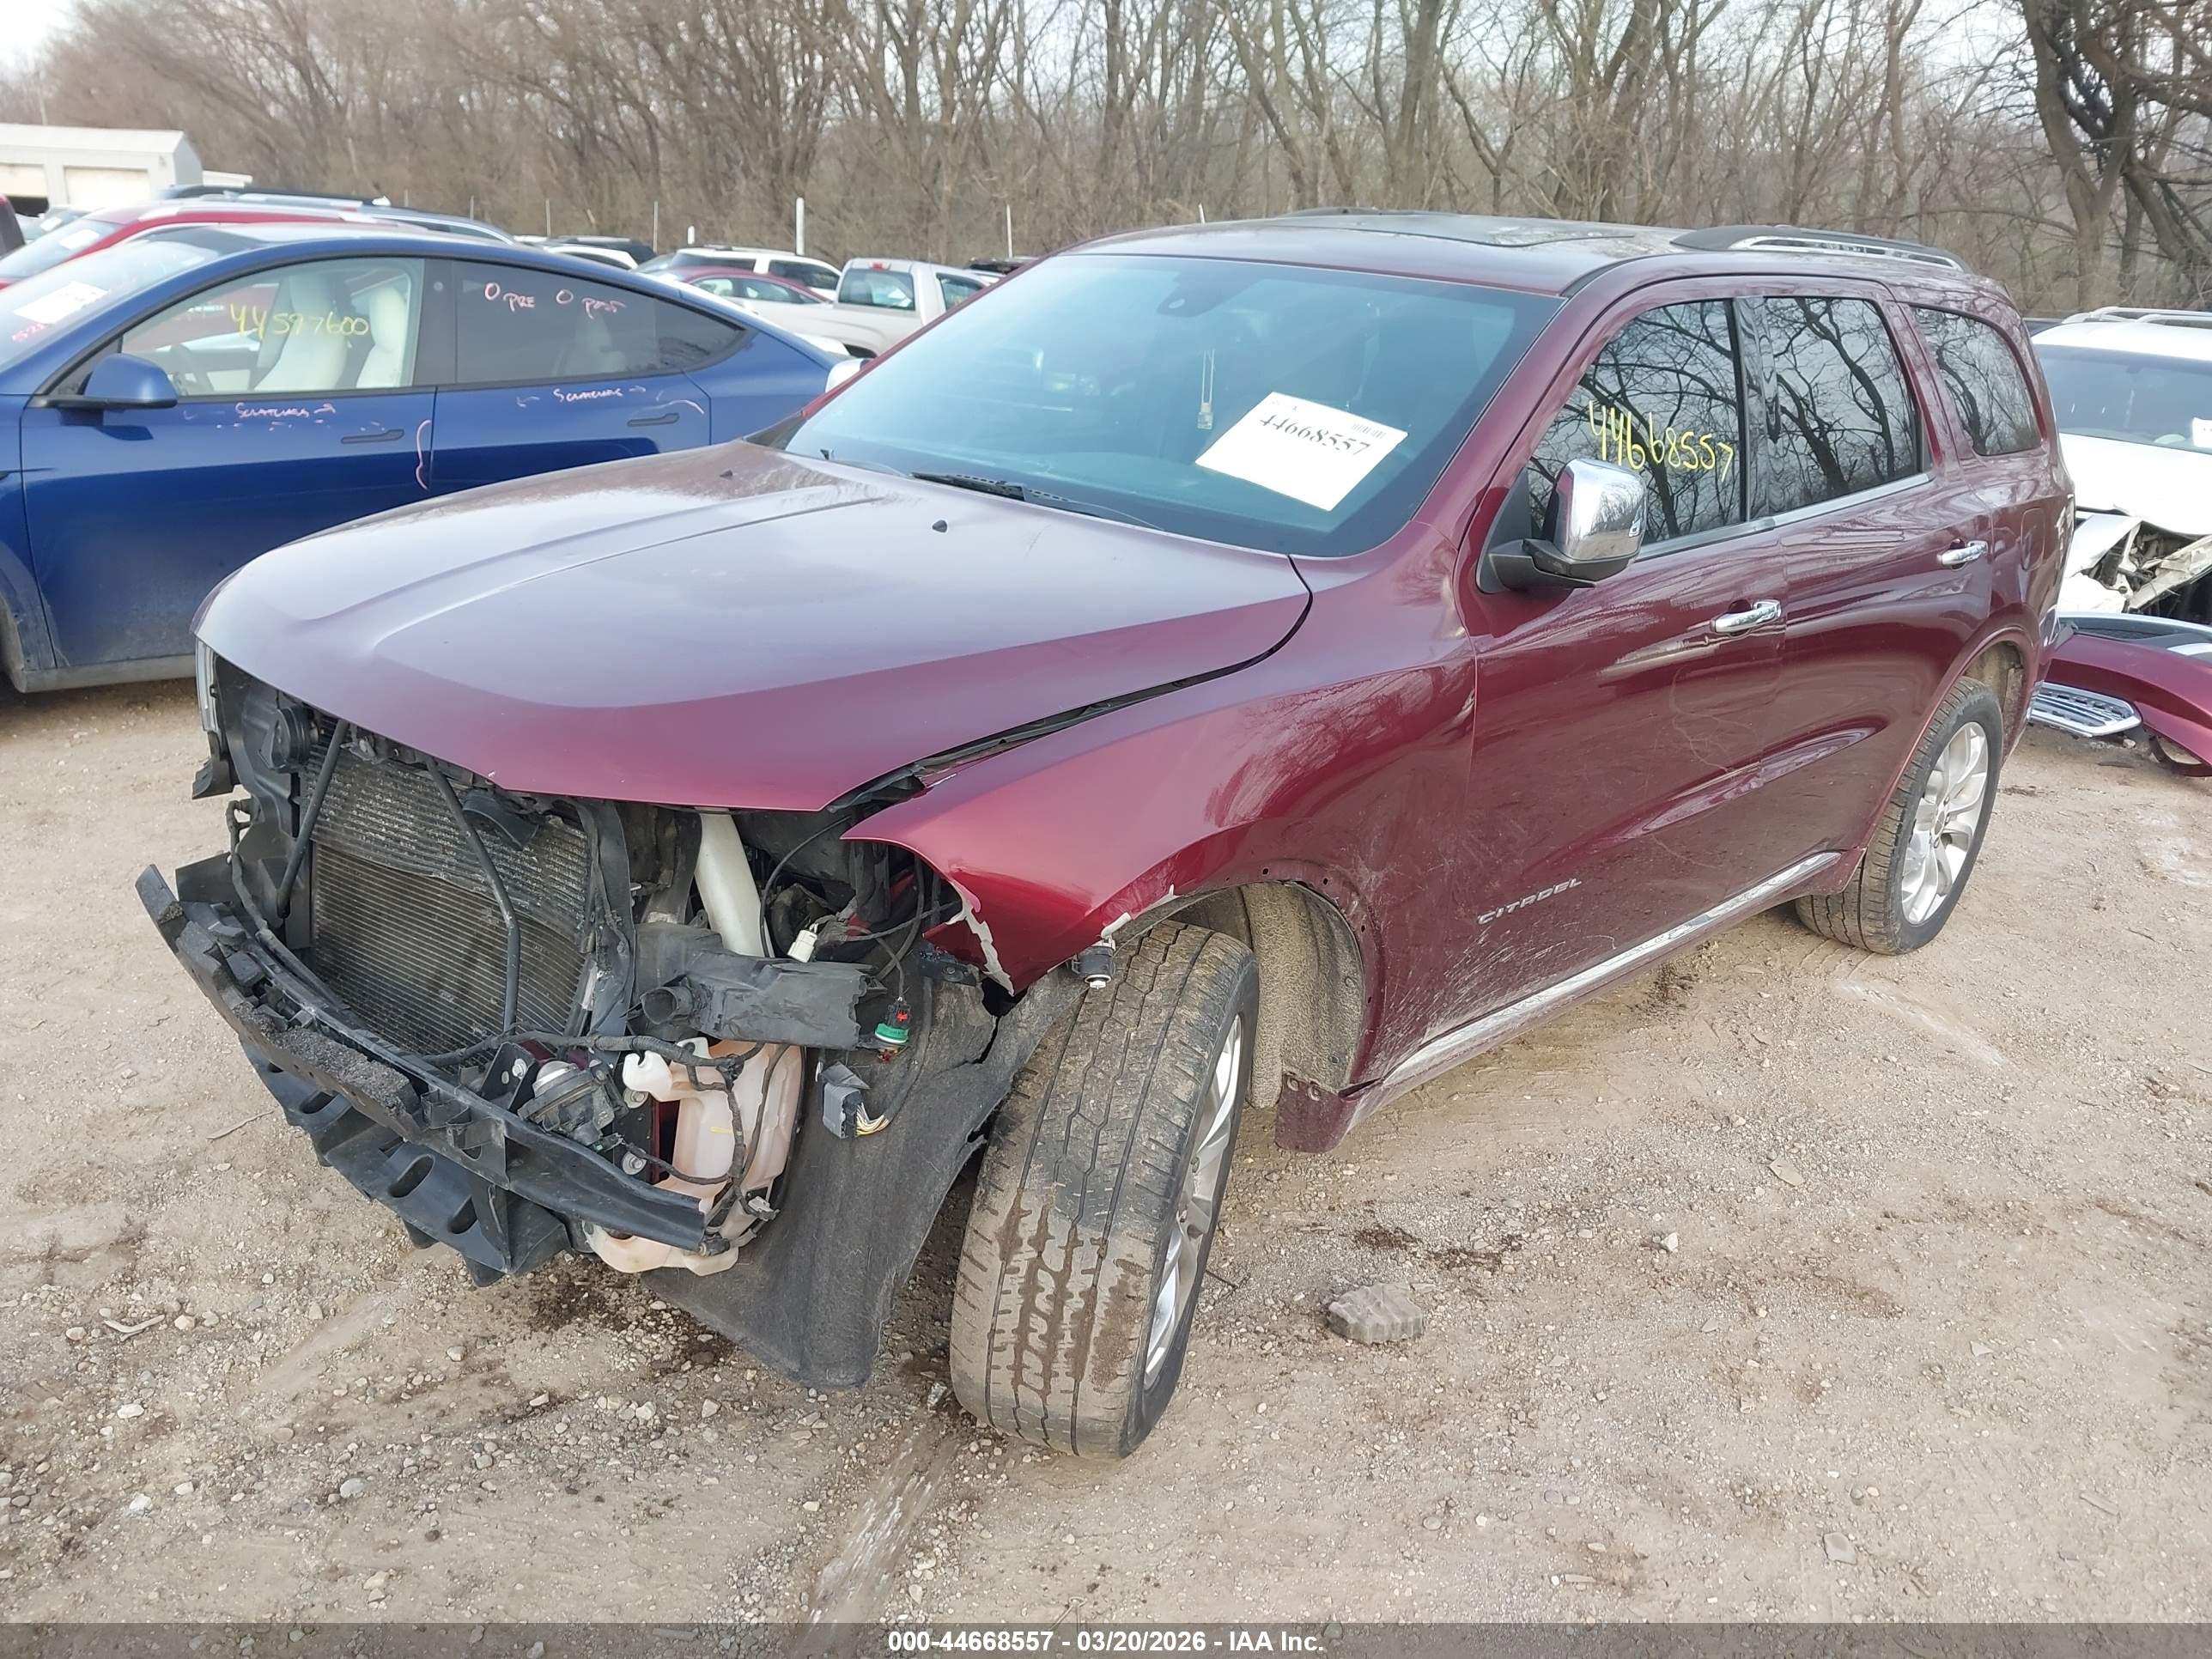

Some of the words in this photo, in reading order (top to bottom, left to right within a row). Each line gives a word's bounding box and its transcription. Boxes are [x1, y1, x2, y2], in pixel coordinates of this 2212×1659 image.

[230, 302, 369, 339] 44597600
[502, 293, 536, 312] PRE
[1260, 414, 1371, 455] 44668557
[1589, 399, 1734, 483] 44668557
[1477, 878, 1582, 924] CITADEL
